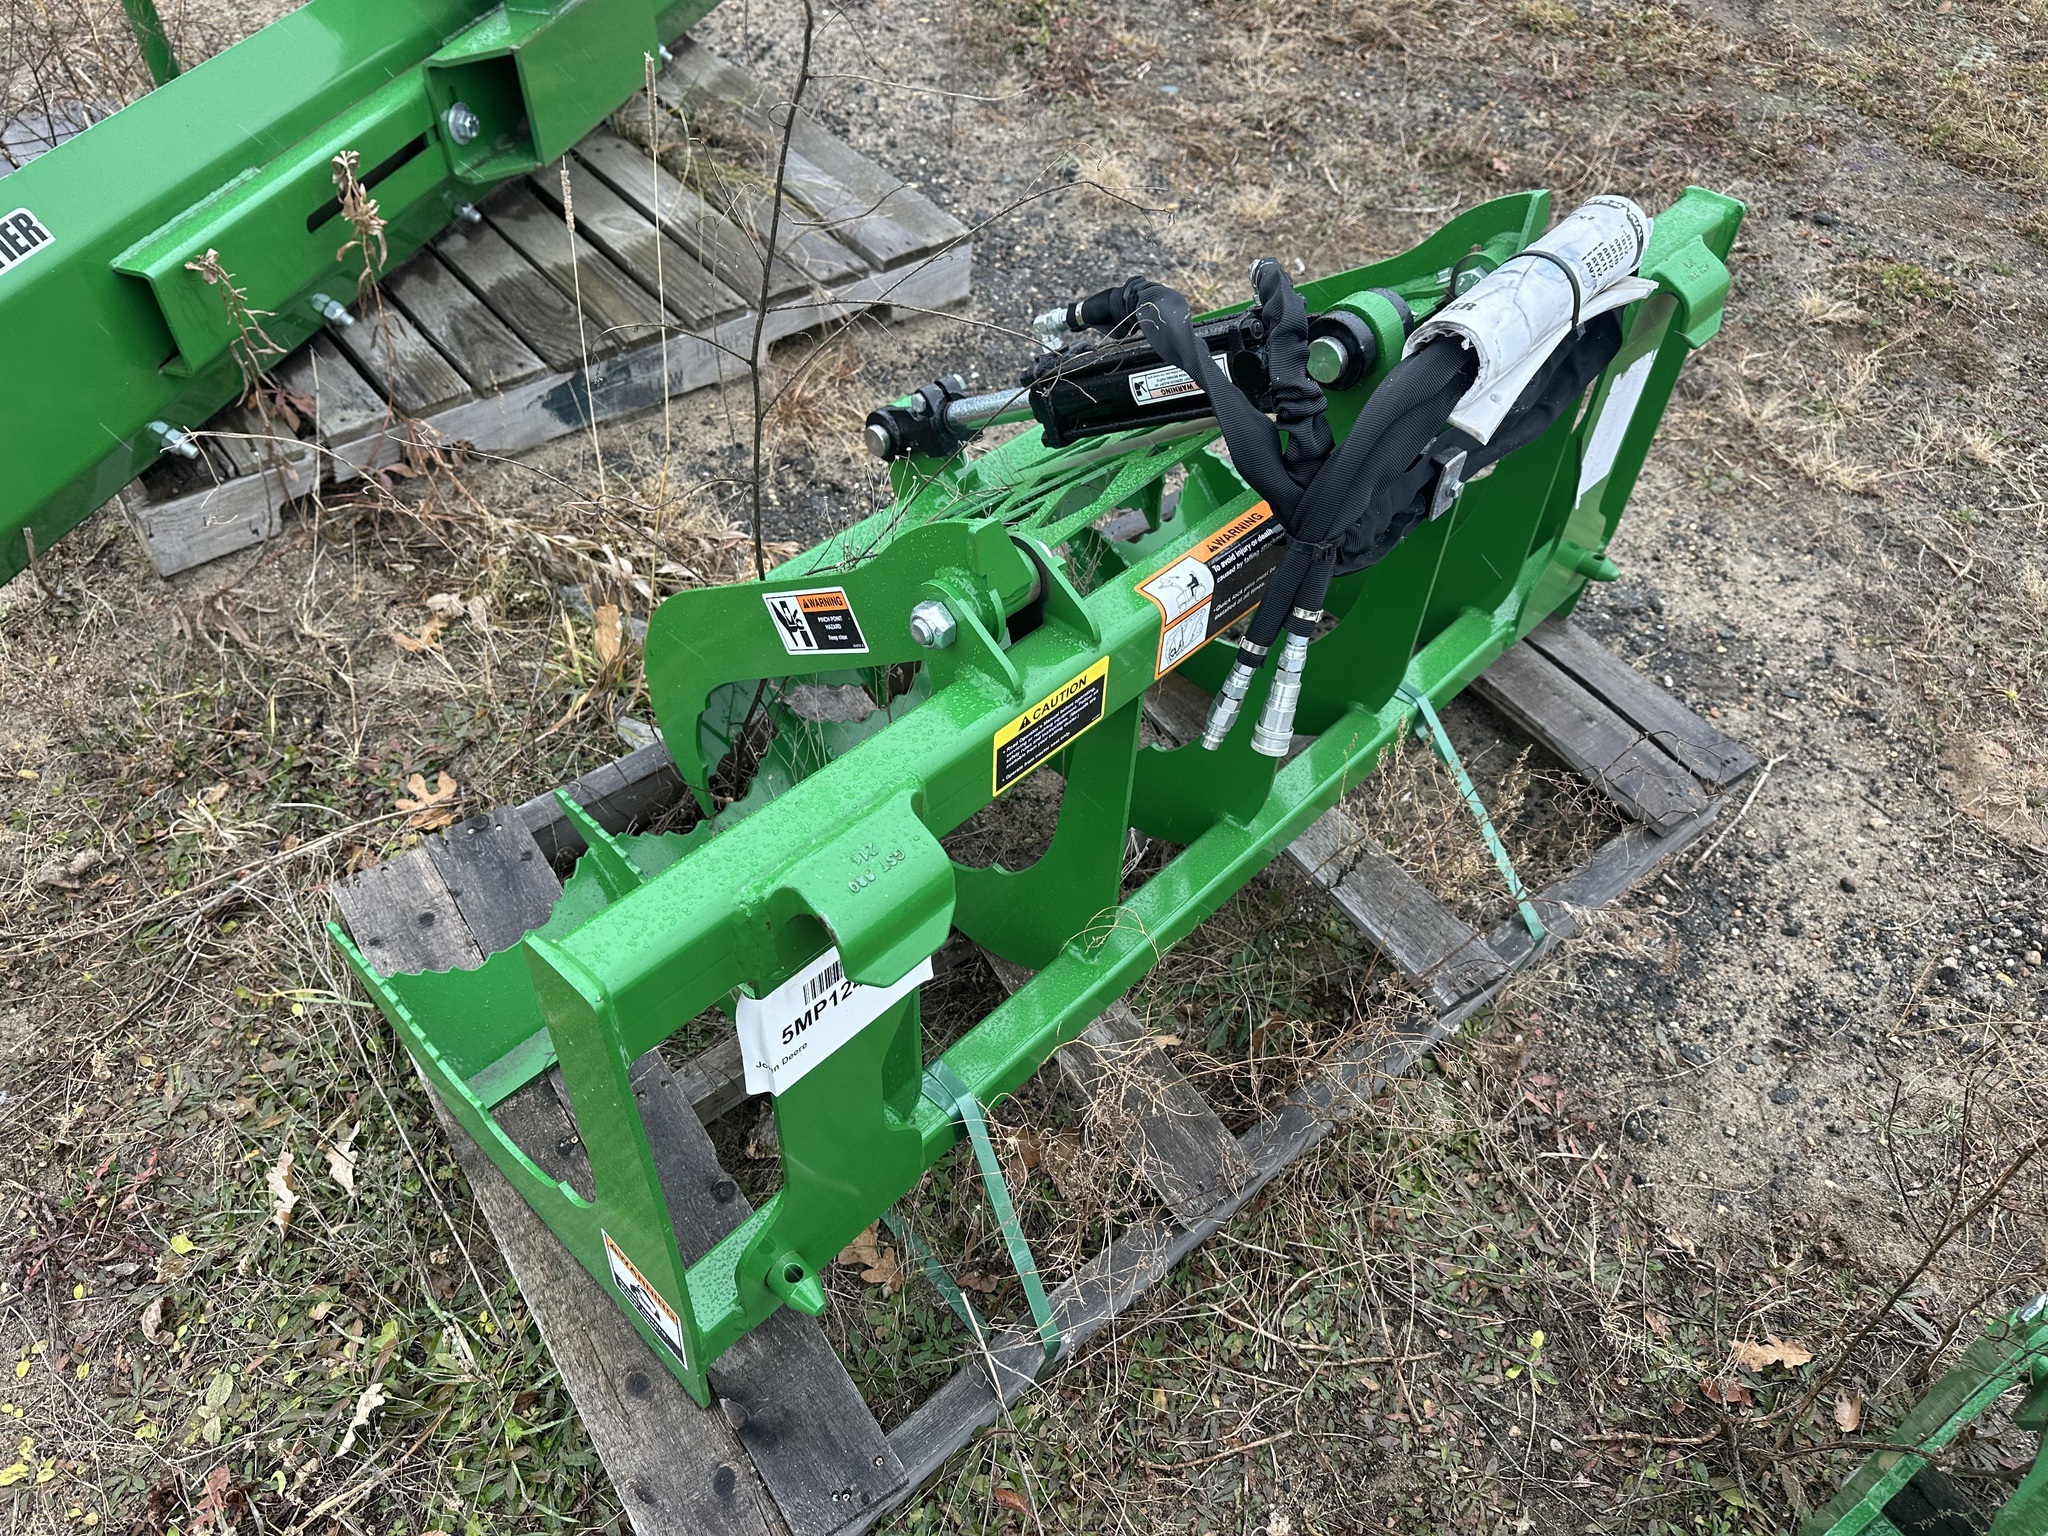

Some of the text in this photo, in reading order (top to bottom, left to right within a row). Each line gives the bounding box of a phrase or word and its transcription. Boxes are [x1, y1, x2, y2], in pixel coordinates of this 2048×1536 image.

[0, 213, 48, 269] IER
[1160, 383, 1194, 395] WARNING
[1215, 512, 1264, 547] WARNING
[1212, 564, 1221, 572] To
[1221, 552, 1236, 568] avoid
[1235, 544, 1251, 557] injury
[1258, 528, 1273, 542] death
[1217, 564, 1236, 583] caused
[1236, 561, 1243, 569] by
[809, 596, 843, 608] WARNING
[1033, 674, 1087, 721] CAUTION
[1006, 740, 1018, 752] Read
[1019, 723, 1042, 744] Operator's
[1043, 711, 1059, 726] Manual
[782, 1042, 808, 1065] Deere
